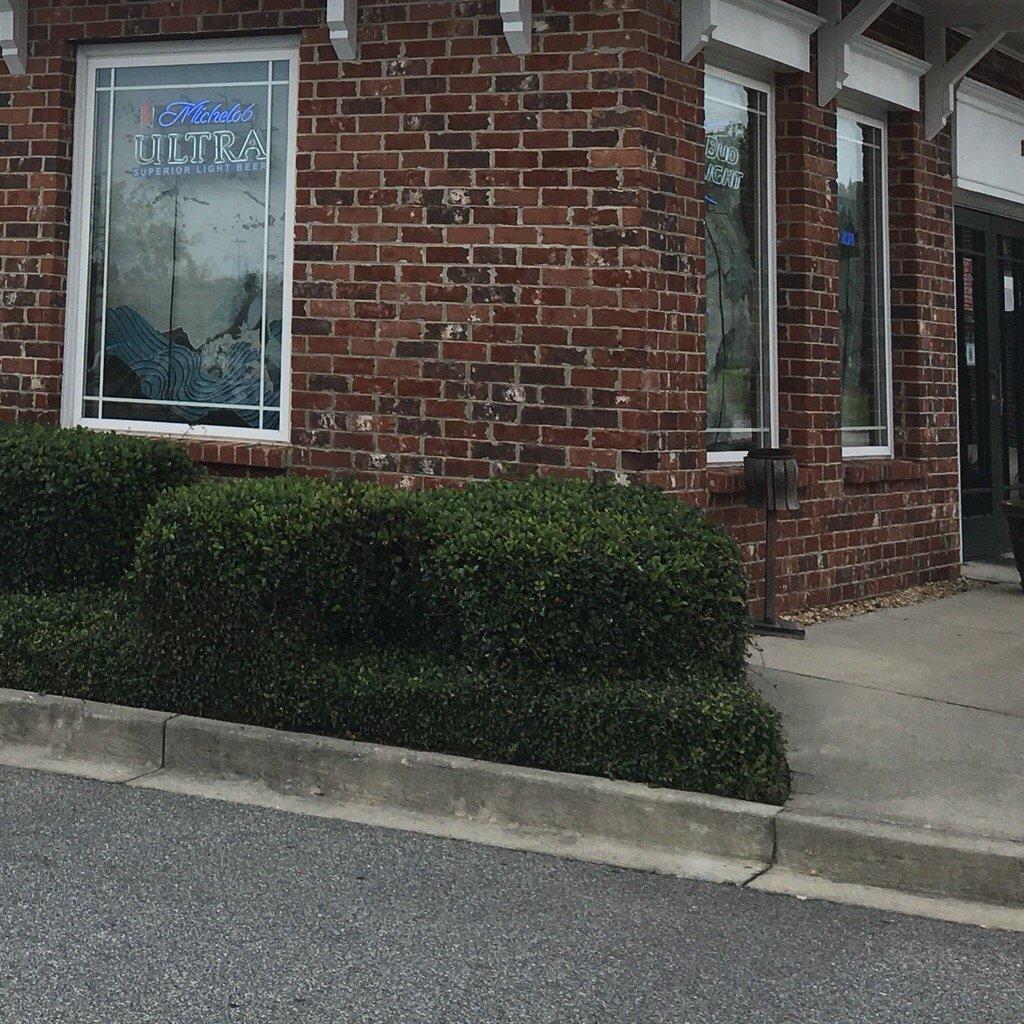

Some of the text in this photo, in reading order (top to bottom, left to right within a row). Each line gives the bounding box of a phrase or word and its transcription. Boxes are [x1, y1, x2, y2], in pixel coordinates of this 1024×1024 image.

[158, 100, 255, 126] Michelob
[133, 129, 269, 166] ULTRA
[705, 135, 739, 165] BUD
[132, 161, 267, 177] SUPERIOR LIGHT BEER
[704, 163, 744, 190] IGHT
